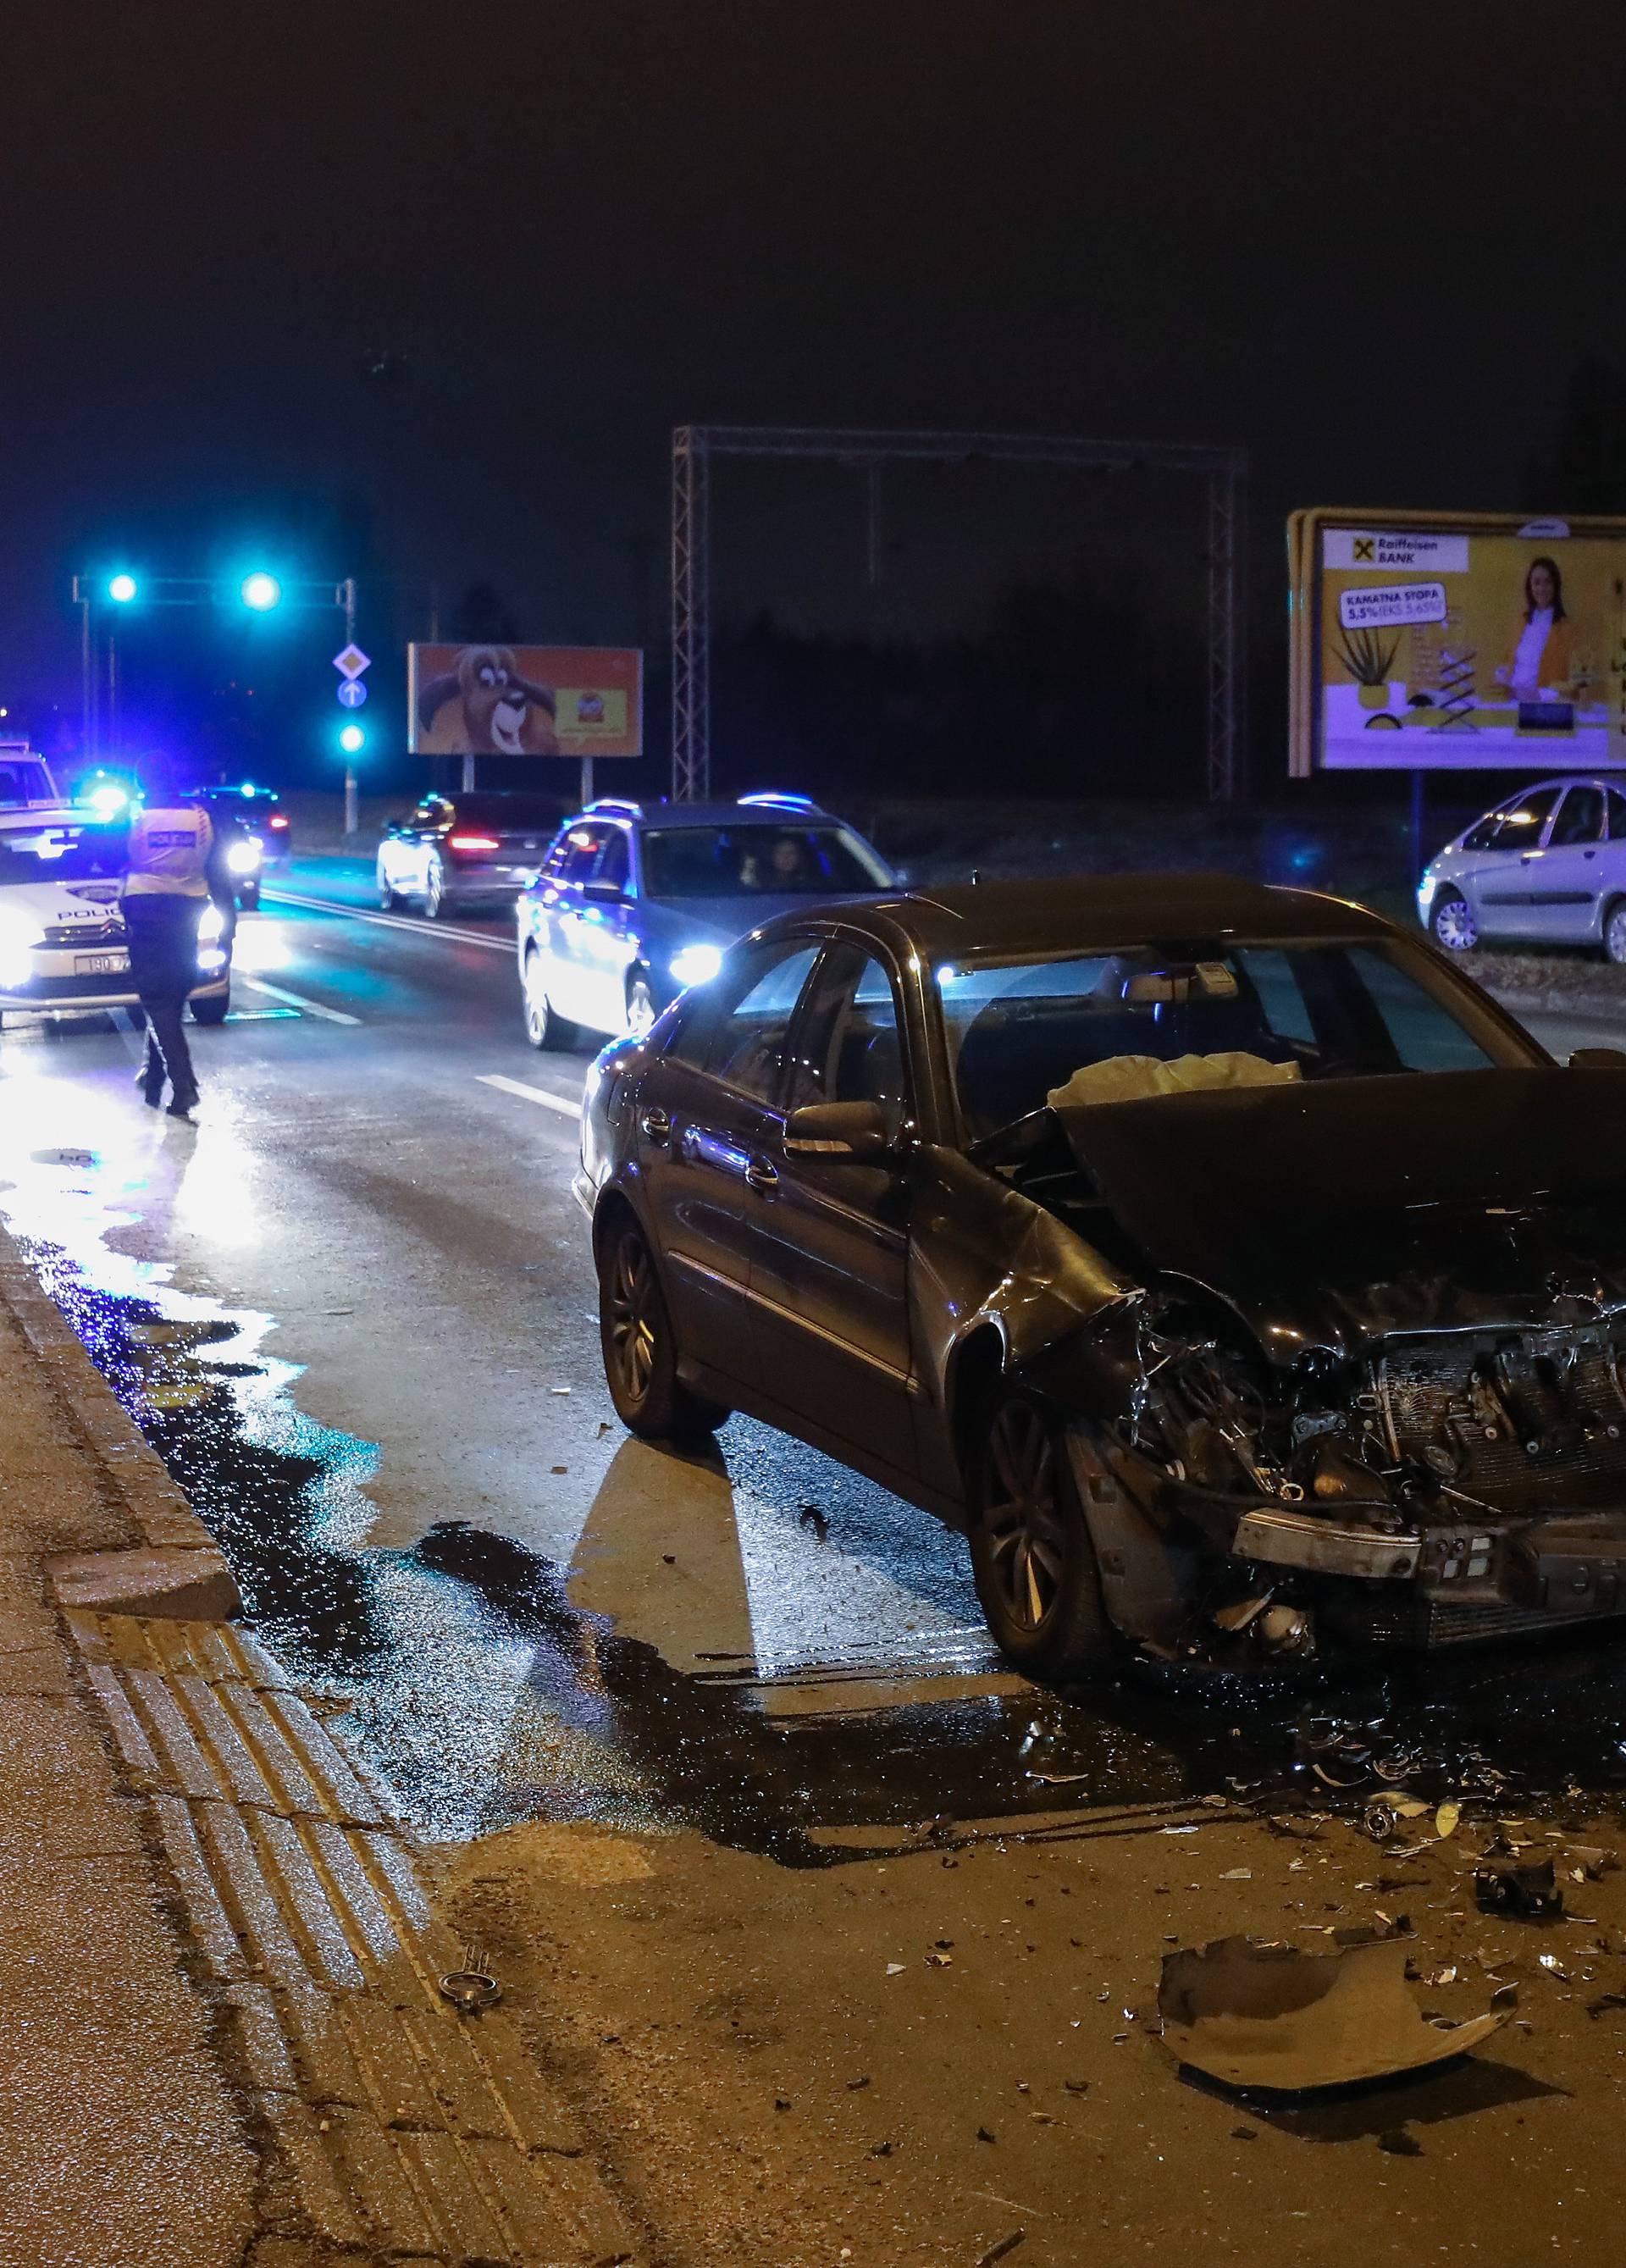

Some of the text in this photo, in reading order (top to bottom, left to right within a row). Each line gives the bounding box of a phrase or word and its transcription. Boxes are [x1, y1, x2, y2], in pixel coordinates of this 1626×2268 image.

[1378, 538, 1438, 550] Raiffeisen
[1379, 553, 1415, 563] BANK
[1347, 589, 1438, 605] KAMATNA STOPA
[57, 908, 122, 920] POLIC
